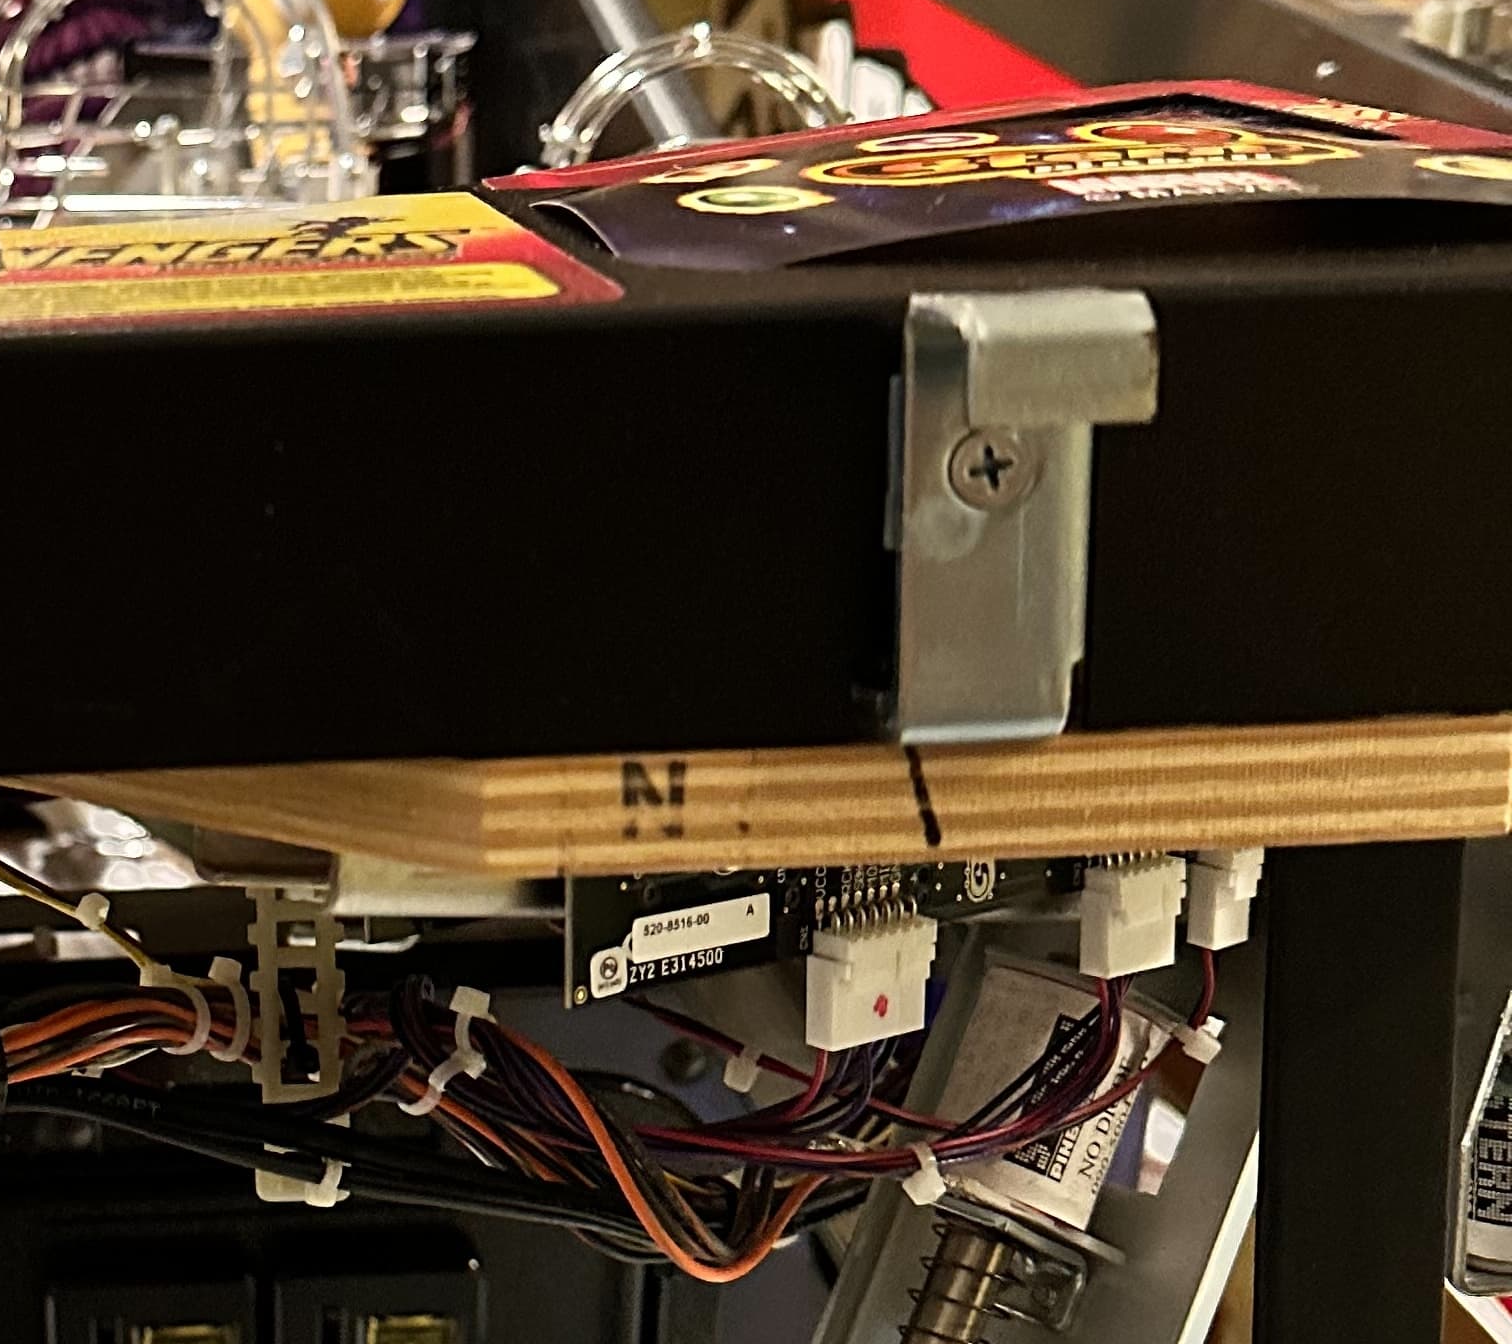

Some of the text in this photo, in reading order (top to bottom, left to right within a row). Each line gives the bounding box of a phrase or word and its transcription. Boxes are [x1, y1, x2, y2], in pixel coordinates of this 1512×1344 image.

[746, 903, 755, 917] A
[629, 947, 724, 984] ZY2 E314500
[1077, 1141, 1101, 1180] NO
